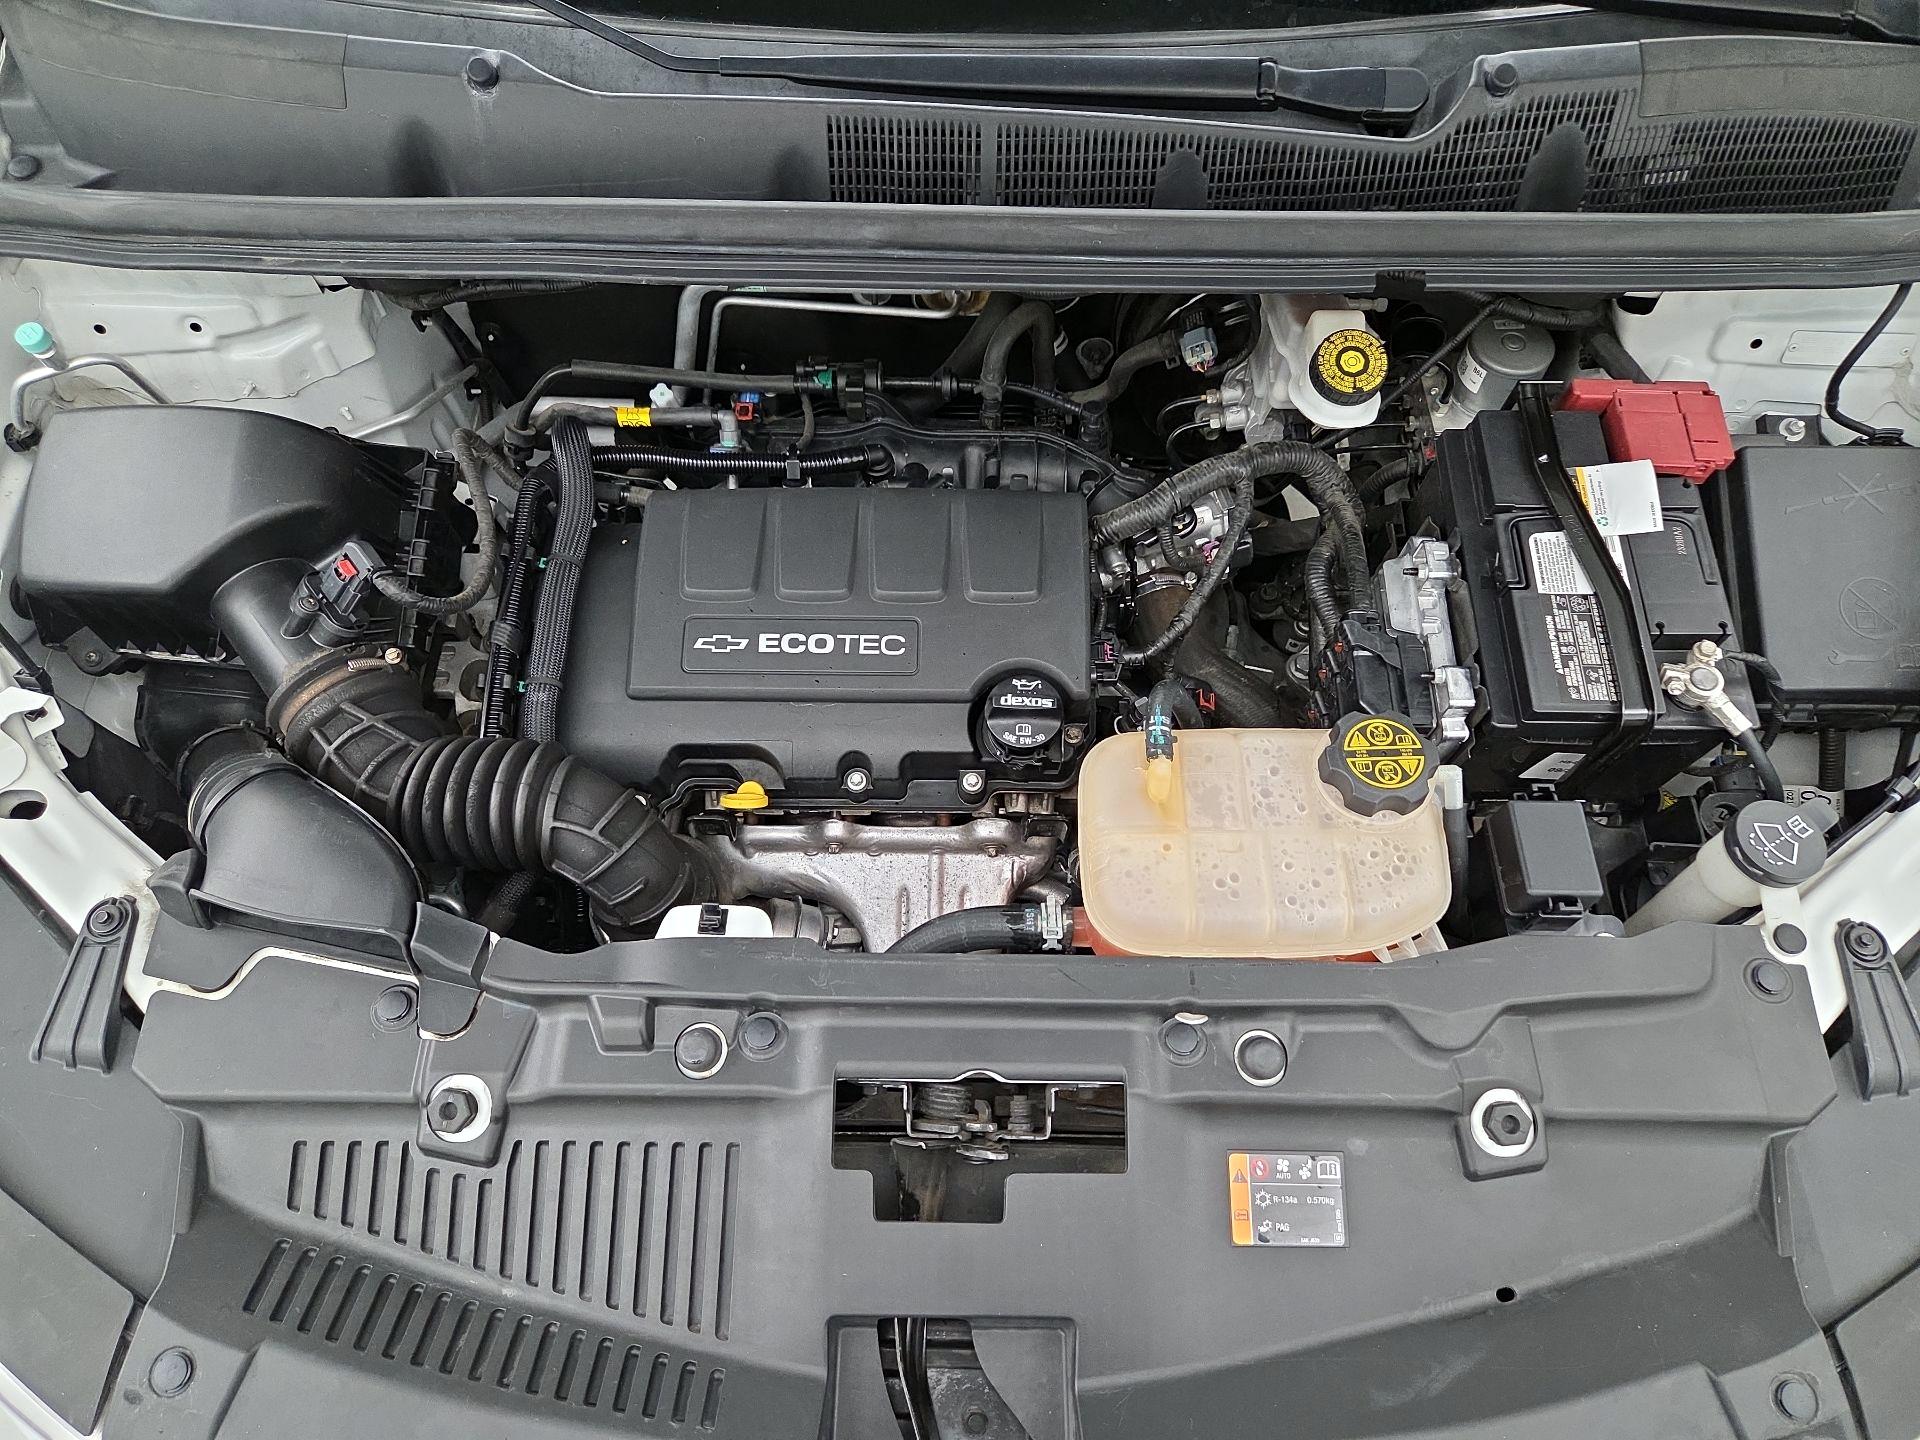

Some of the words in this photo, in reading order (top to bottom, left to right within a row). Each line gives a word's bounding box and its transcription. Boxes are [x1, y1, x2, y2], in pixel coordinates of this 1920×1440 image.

[757, 633, 907, 656] ECOTEC
[1000, 693, 1054, 708] dexos
[1003, 731, 1018, 744] SAE
[1019, 733, 1046, 745] 5W-30
[1275, 1172, 1291, 1180] AUTO
[1272, 1195, 1298, 1205] R-134a
[1306, 1195, 1336, 1206] 0.570kg
[1275, 1222, 1290, 1232] PAG
